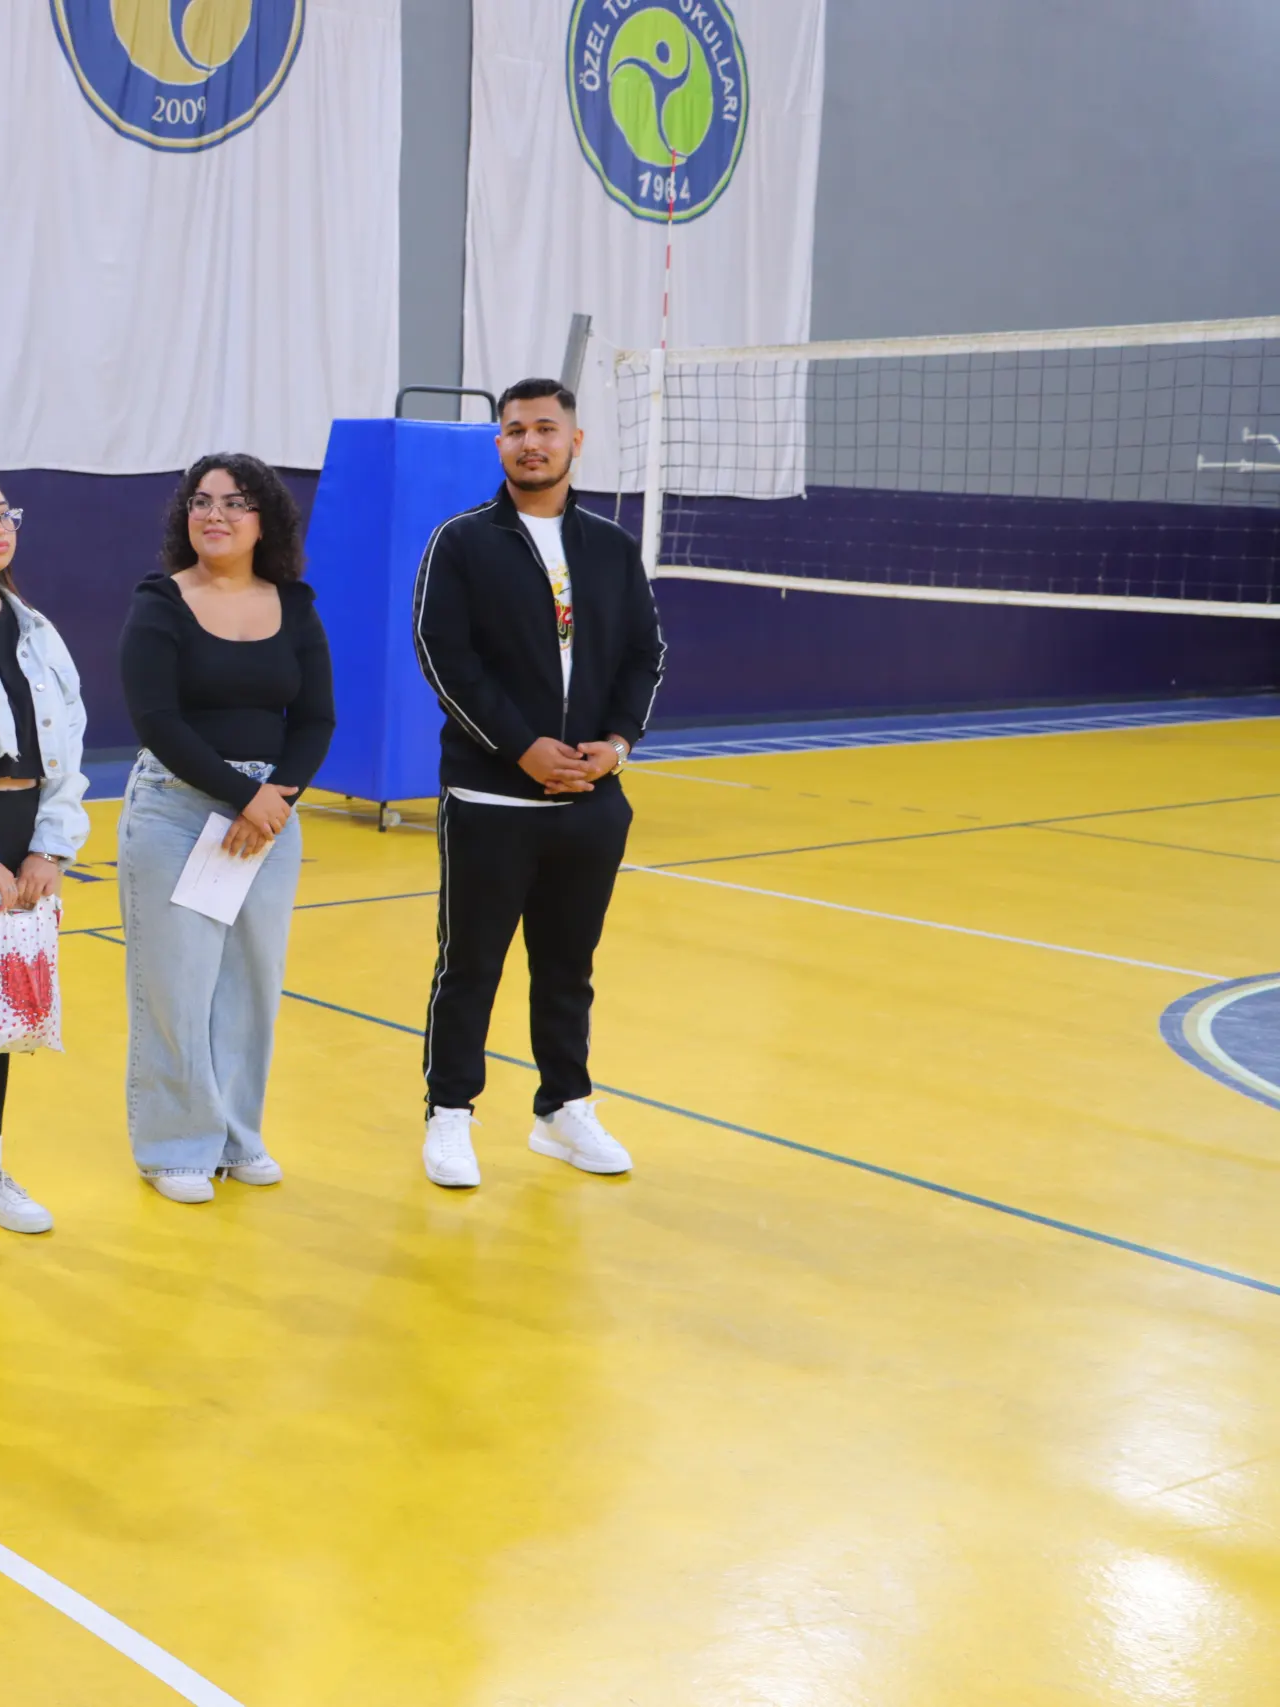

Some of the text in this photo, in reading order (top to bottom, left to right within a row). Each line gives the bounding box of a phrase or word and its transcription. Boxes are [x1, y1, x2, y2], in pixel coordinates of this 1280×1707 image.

[579, 20, 610, 92] ÖZEL
[151, 95, 207, 125] 2009
[637, 171, 691, 205] 1964
